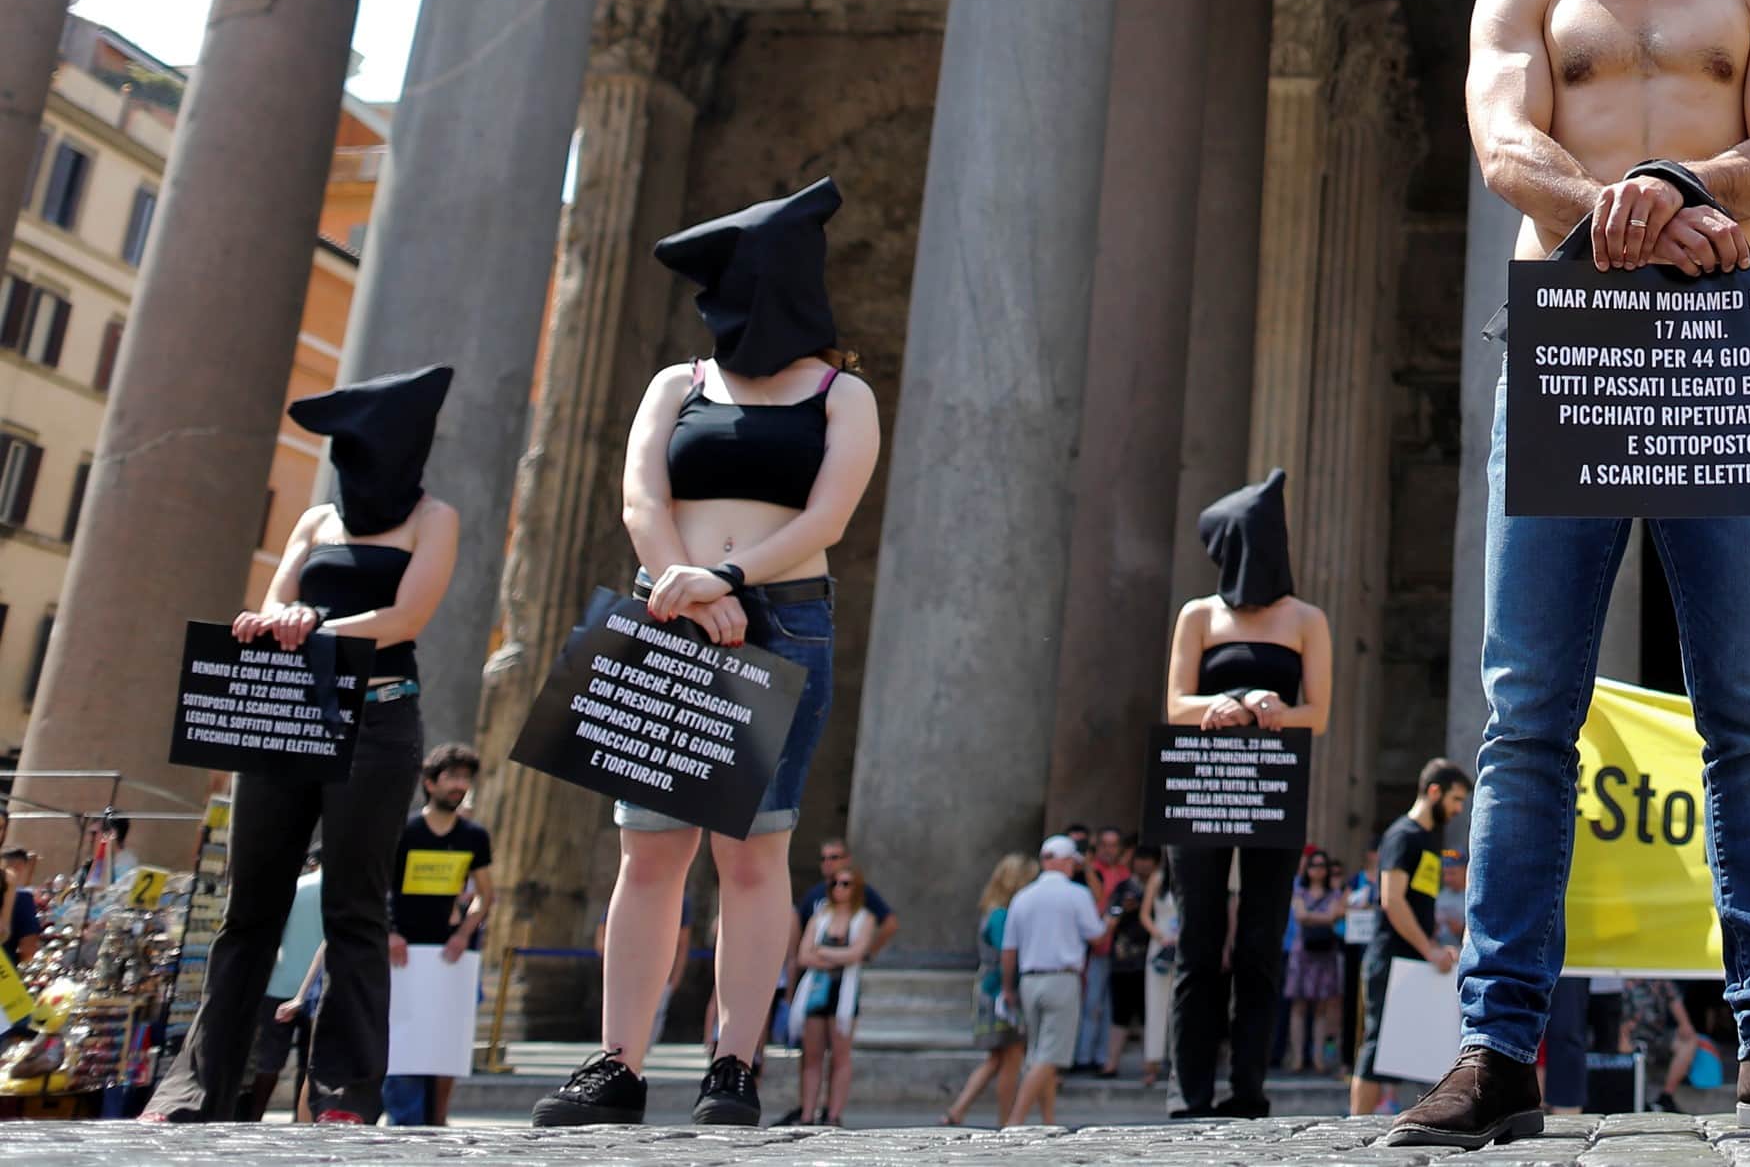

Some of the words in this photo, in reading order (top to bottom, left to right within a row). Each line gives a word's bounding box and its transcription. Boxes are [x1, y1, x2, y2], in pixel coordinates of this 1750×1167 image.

[1536, 287, 1587, 309] OMAR
[1592, 289, 1650, 311] AYMAN
[1656, 290, 1744, 312] MOHAMED
[1654, 320, 1674, 340] 17
[1681, 319, 1728, 340] ANNI.
[1535, 345, 1645, 368] SCOMPARSO
[1651, 348, 1686, 368] PER
[1692, 348, 1714, 368] 44
[1539, 374, 1587, 396] TUTTI
[1593, 376, 1665, 397] PASSATI
[1671, 376, 1736, 397] LEGATO
[1559, 404, 1655, 426] PICCHIATO
[1627, 435, 1638, 455] E
[1580, 464, 1591, 485] A
[1597, 464, 1687, 485] SCARICHE
[607, 615, 637, 636] OMAR
[637, 625, 697, 657] MOHAMED
[698, 647, 720, 668] ALI,
[723, 656, 740, 673] 23
[740, 663, 770, 687] ANNI,
[644, 651, 713, 686] ARRESTATO
[592, 656, 621, 677] SOLO
[671, 683, 752, 724] PASSAGGIAVA
[589, 678, 614, 698] CON
[614, 687, 674, 719] PRESUNTI
[675, 709, 733, 741] ATTIVISTI.
[571, 695, 641, 731] SCOMPARSO
[642, 720, 669, 741] PER
[672, 730, 688, 747] 16
[689, 737, 735, 765] GIORNI.
[577, 721, 650, 758] MINACCIATO
[650, 747, 666, 764] DI
[667, 752, 711, 779] MORTE
[591, 750, 600, 765] E
[603, 754, 672, 791] TORTURATO.
